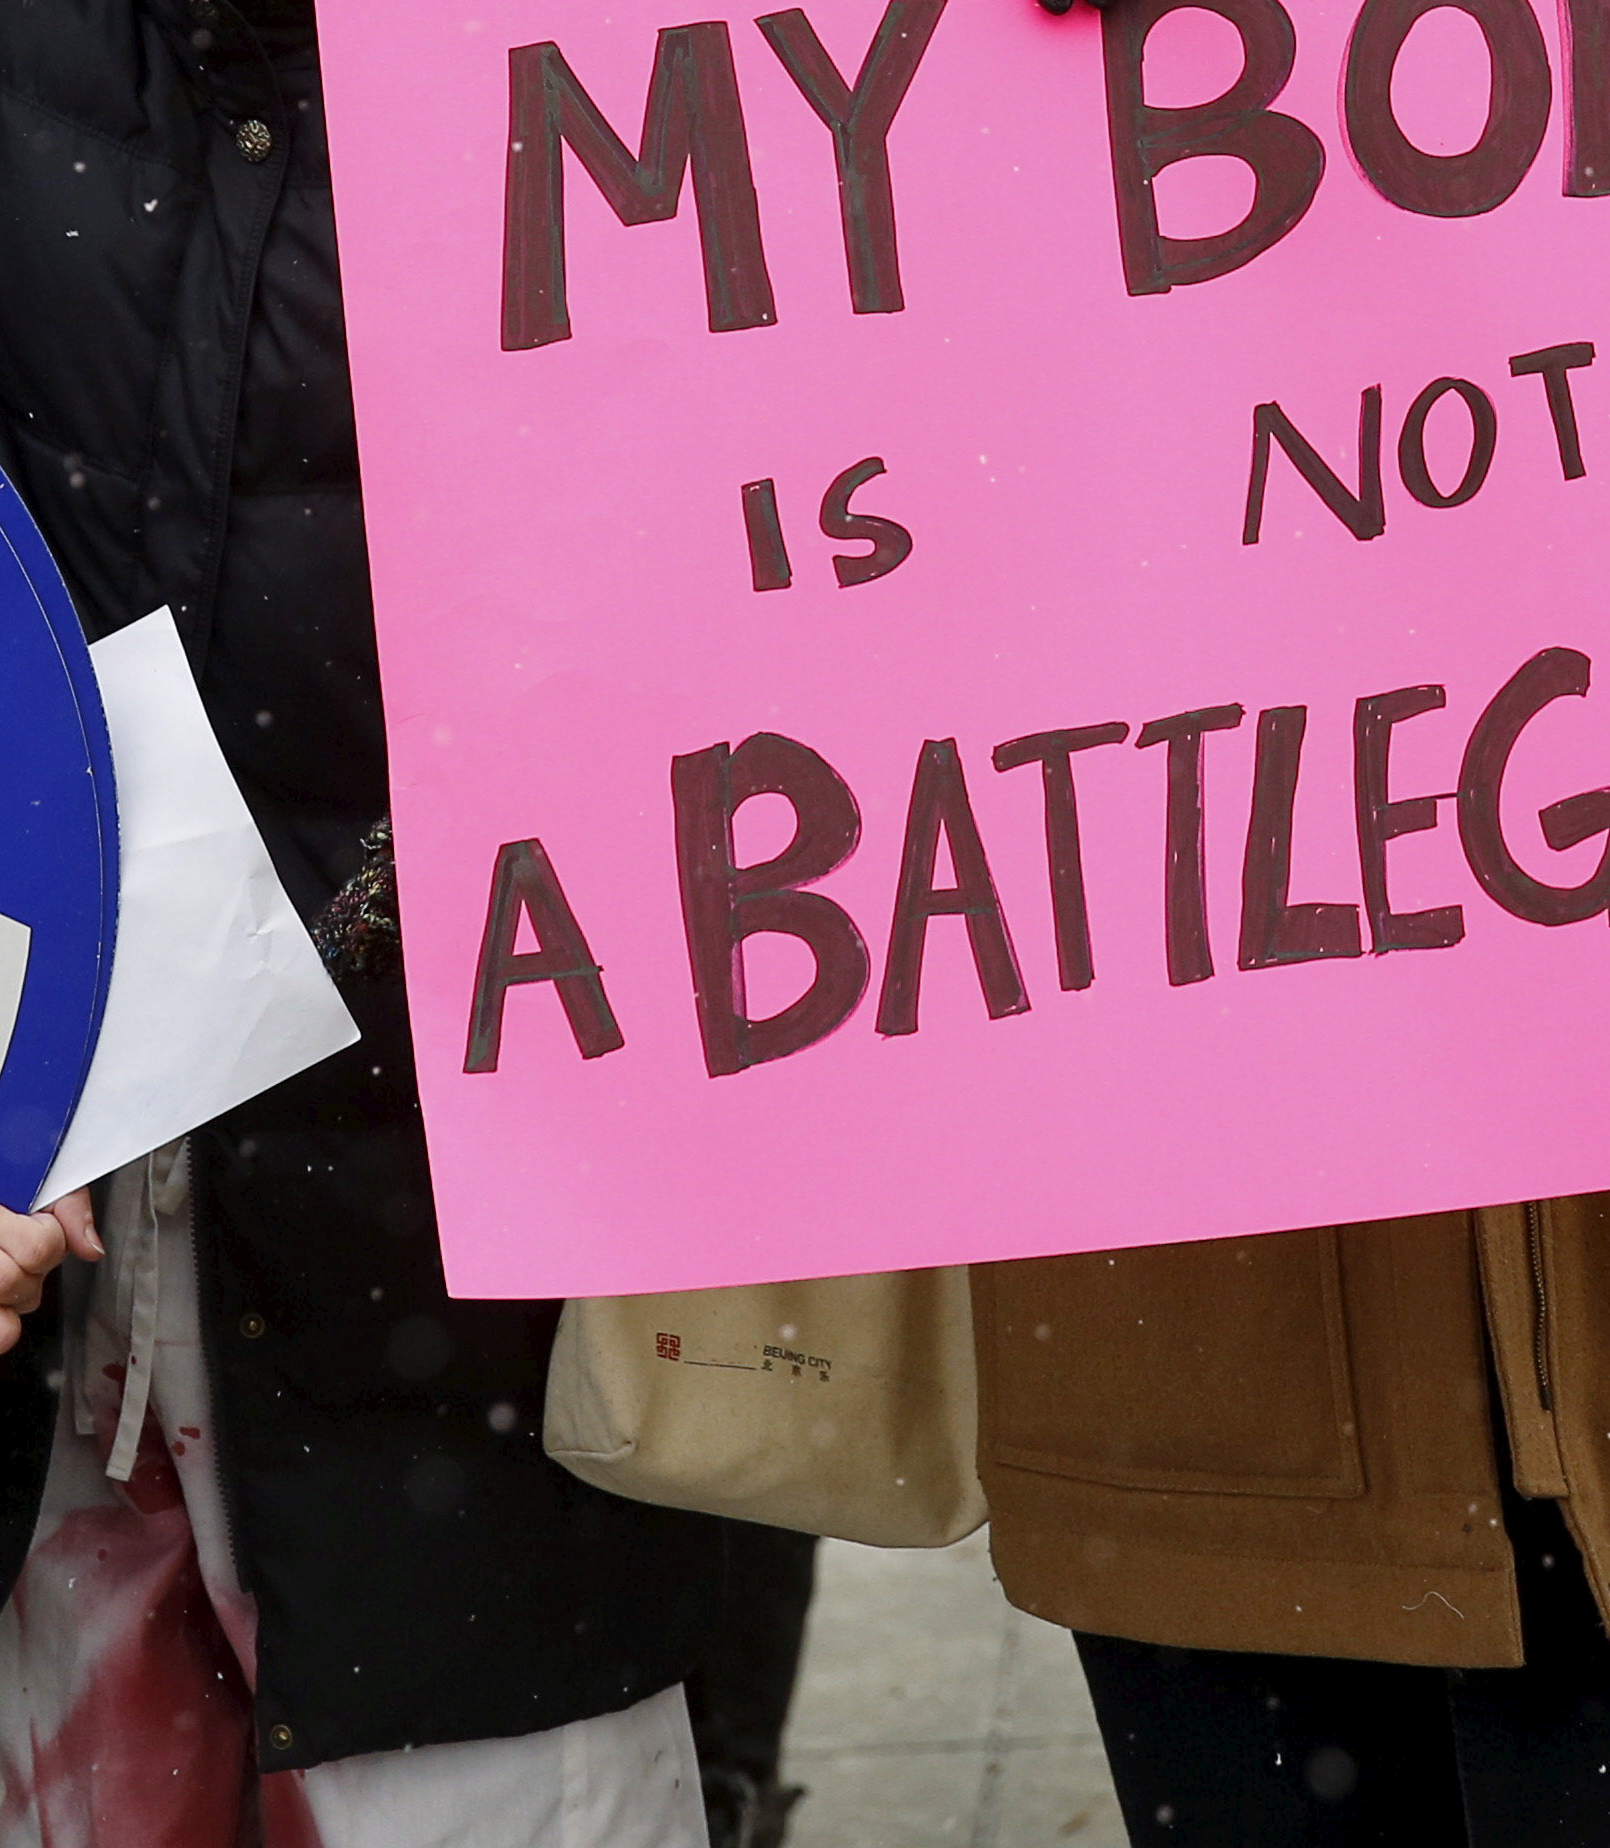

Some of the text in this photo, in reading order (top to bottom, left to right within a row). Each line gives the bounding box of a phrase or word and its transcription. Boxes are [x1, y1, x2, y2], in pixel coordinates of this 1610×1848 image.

[744, 341, 1596, 592] IS NOT
[462, 837, 624, 1073] A
[808, 1355, 832, 1370] CITY
